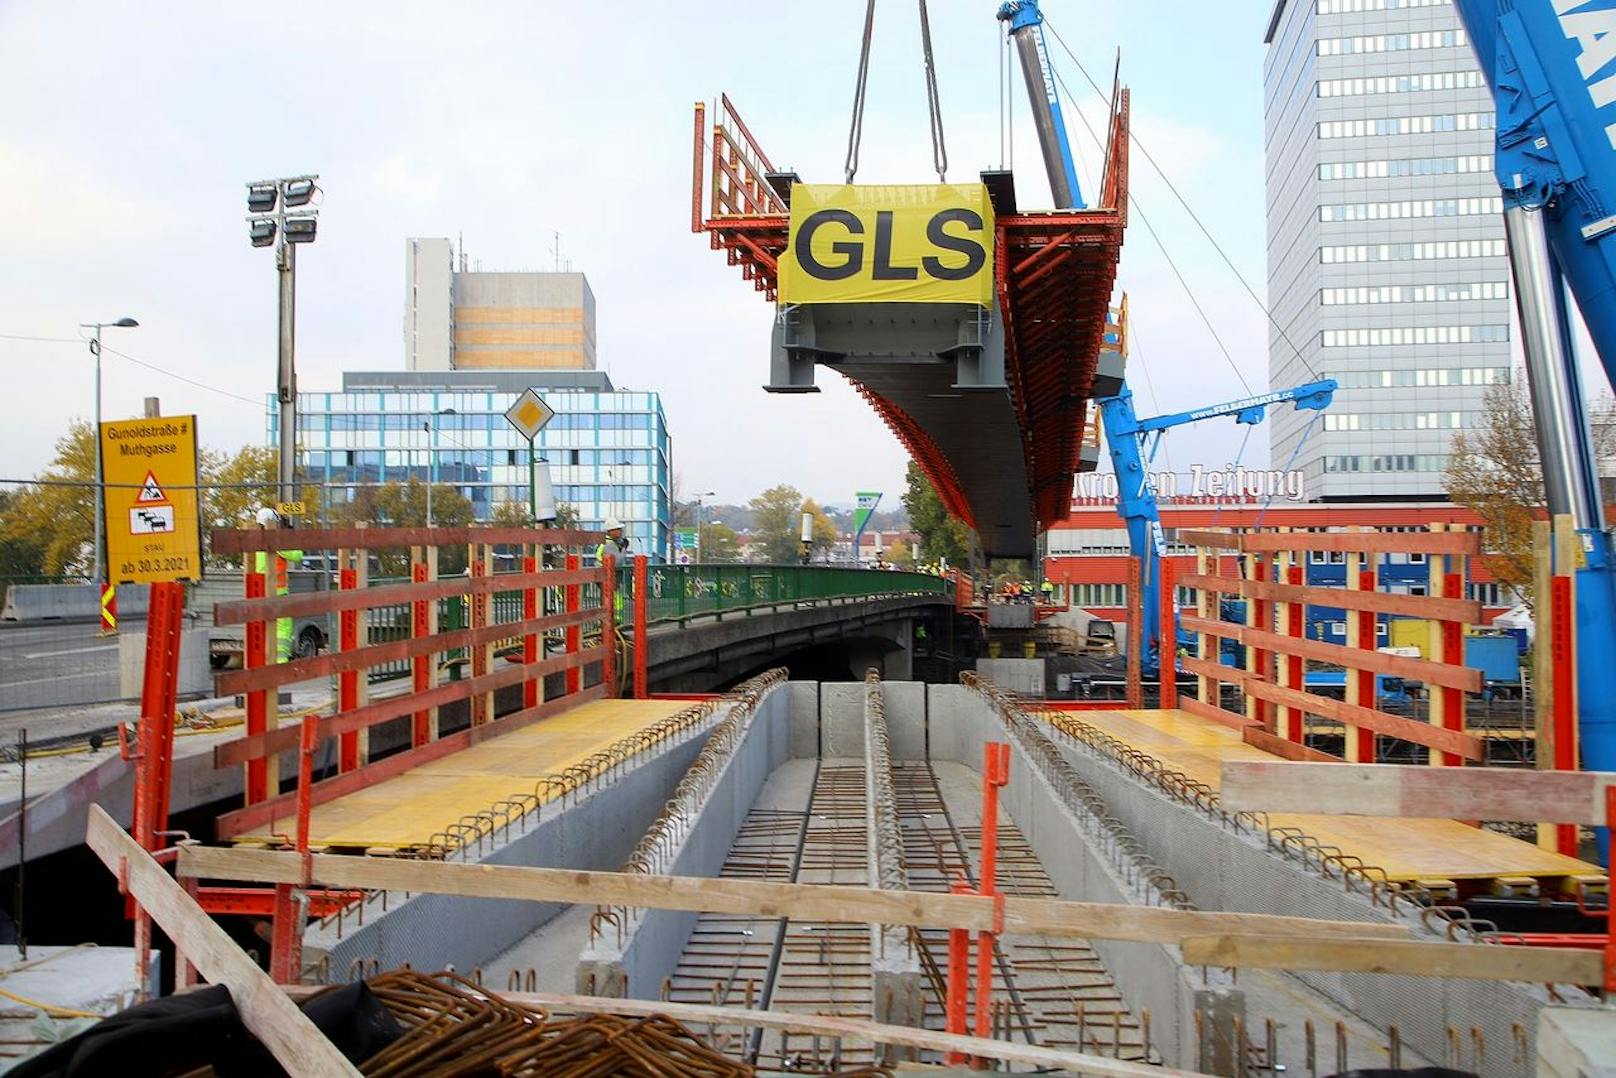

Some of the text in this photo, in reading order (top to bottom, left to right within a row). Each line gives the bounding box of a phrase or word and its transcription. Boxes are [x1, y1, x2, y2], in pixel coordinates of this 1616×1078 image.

[795, 208, 986, 281] GLS
[107, 423, 178, 440] Gunoldstraße
[120, 443, 176, 459] Muthgasse
[1071, 471, 1176, 499] Kroen
[1190, 463, 1304, 500] Zeitung
[121, 556, 189, 575] ab 30.3.2021
